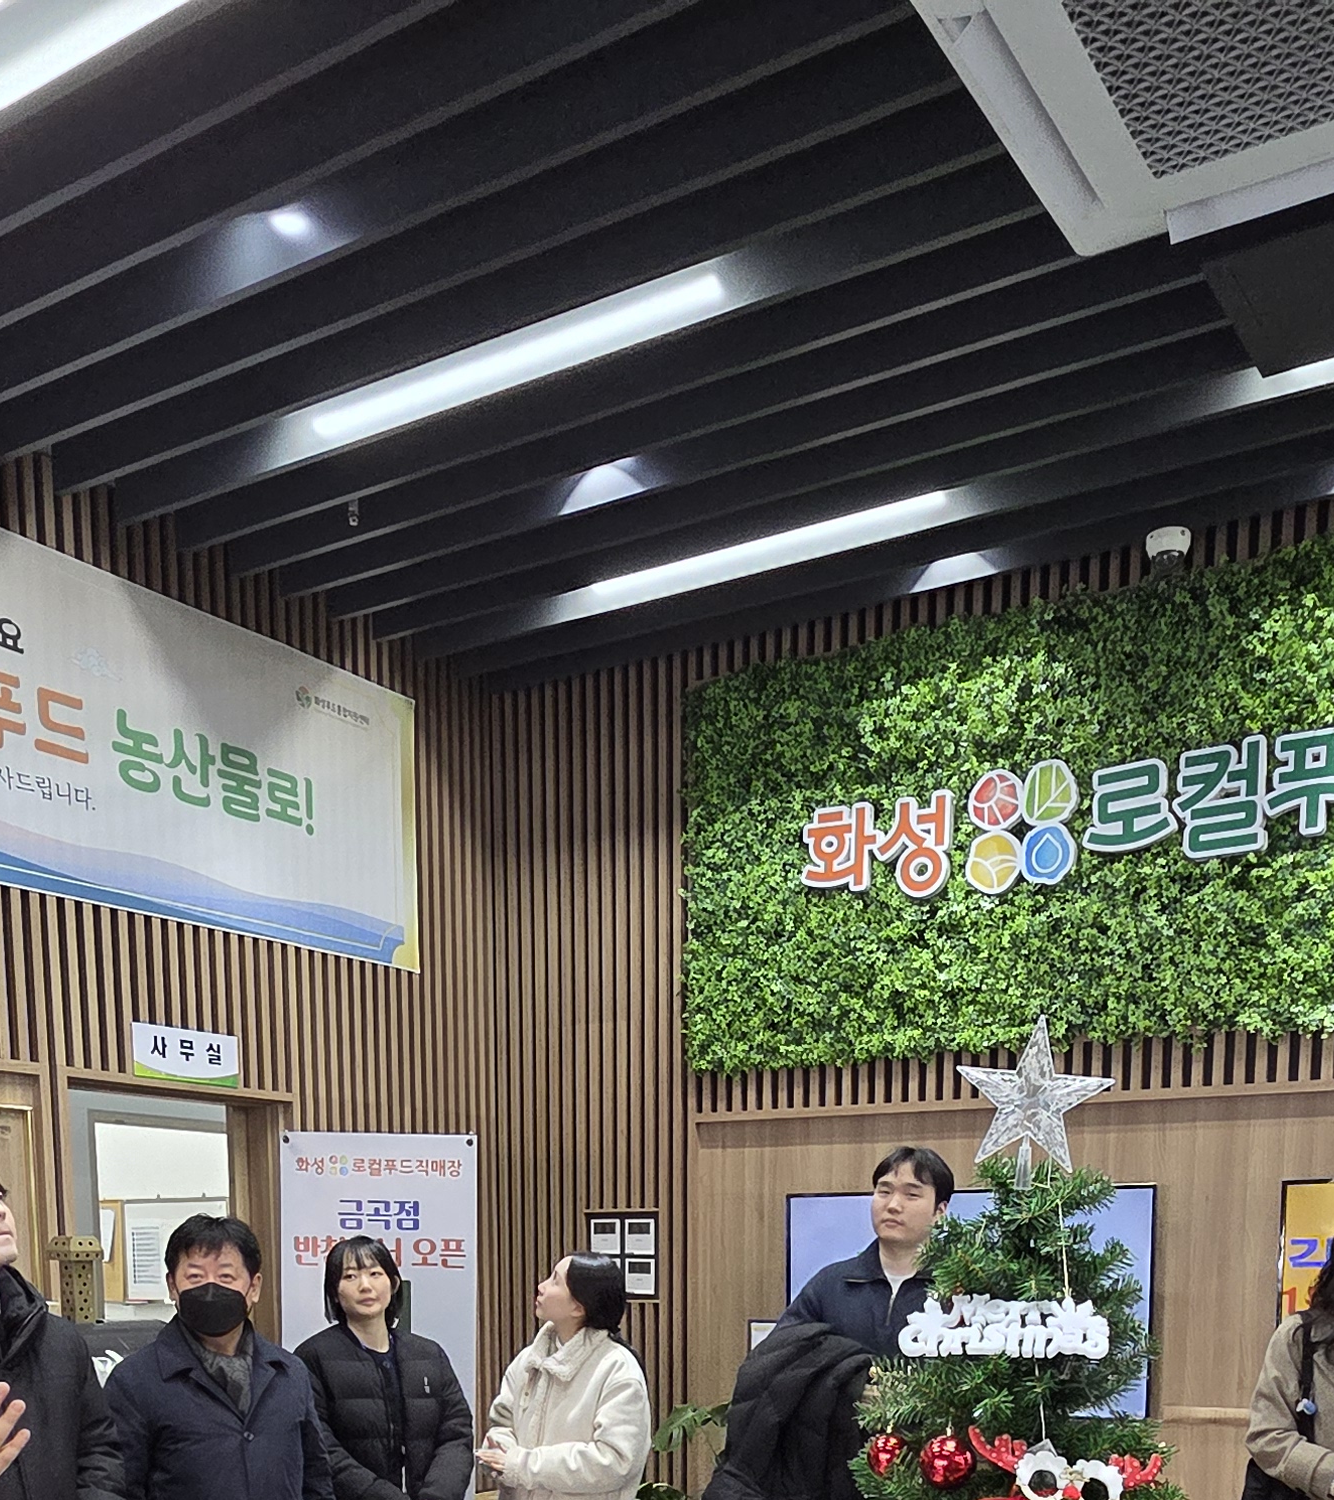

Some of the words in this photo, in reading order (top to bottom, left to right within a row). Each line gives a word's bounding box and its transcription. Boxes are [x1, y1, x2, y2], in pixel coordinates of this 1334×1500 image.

[114, 707, 316, 836] 농산물로!
[804, 793, 949, 896] 화성
[296, 1156, 325, 1176] 화성
[352, 1157, 463, 1178] 로컬푸드직매장
[338, 1199, 420, 1231] 금곡점
[411, 1238, 466, 1269] 오픈
[898, 1323, 1110, 1360] Christmas
